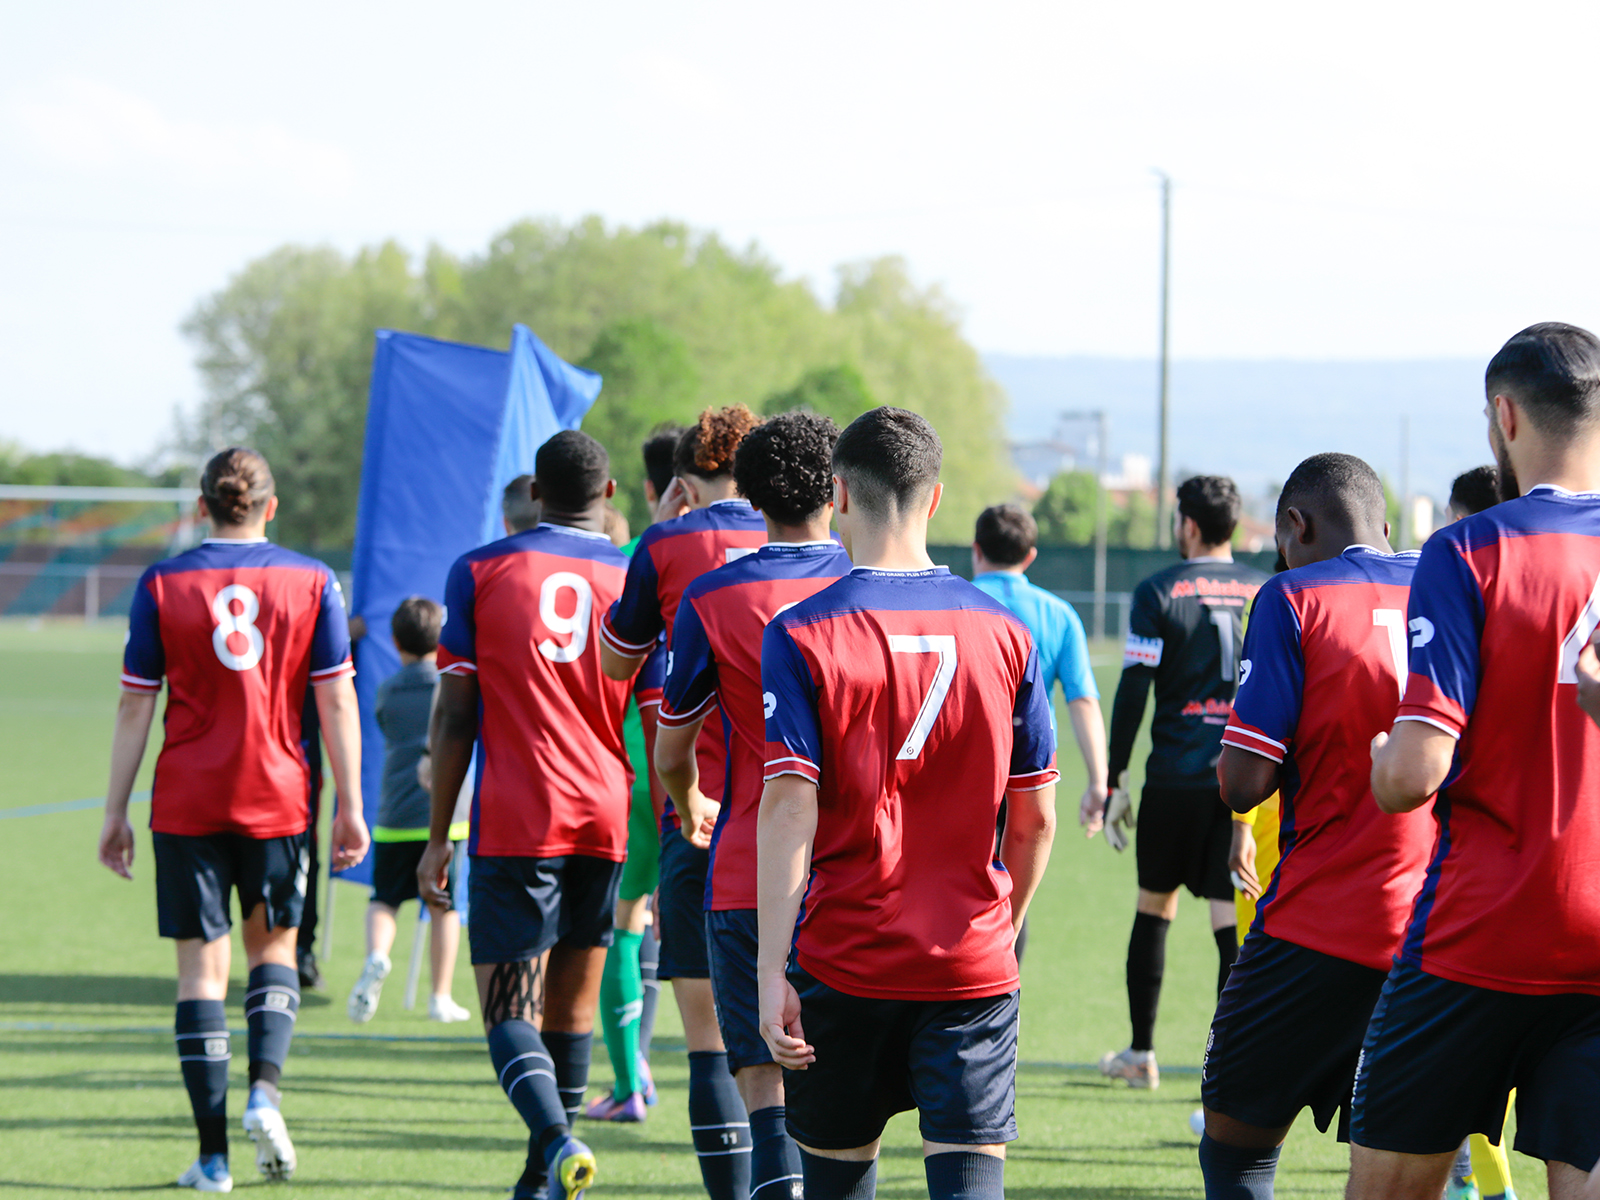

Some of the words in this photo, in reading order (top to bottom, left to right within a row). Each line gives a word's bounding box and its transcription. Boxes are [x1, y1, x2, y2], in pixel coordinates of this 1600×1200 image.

[211, 583, 265, 672] 8
[537, 571, 593, 663] 9
[1209, 610, 1234, 682] 1
[888, 634, 958, 760] 7
[720, 1131, 738, 1145] 11
